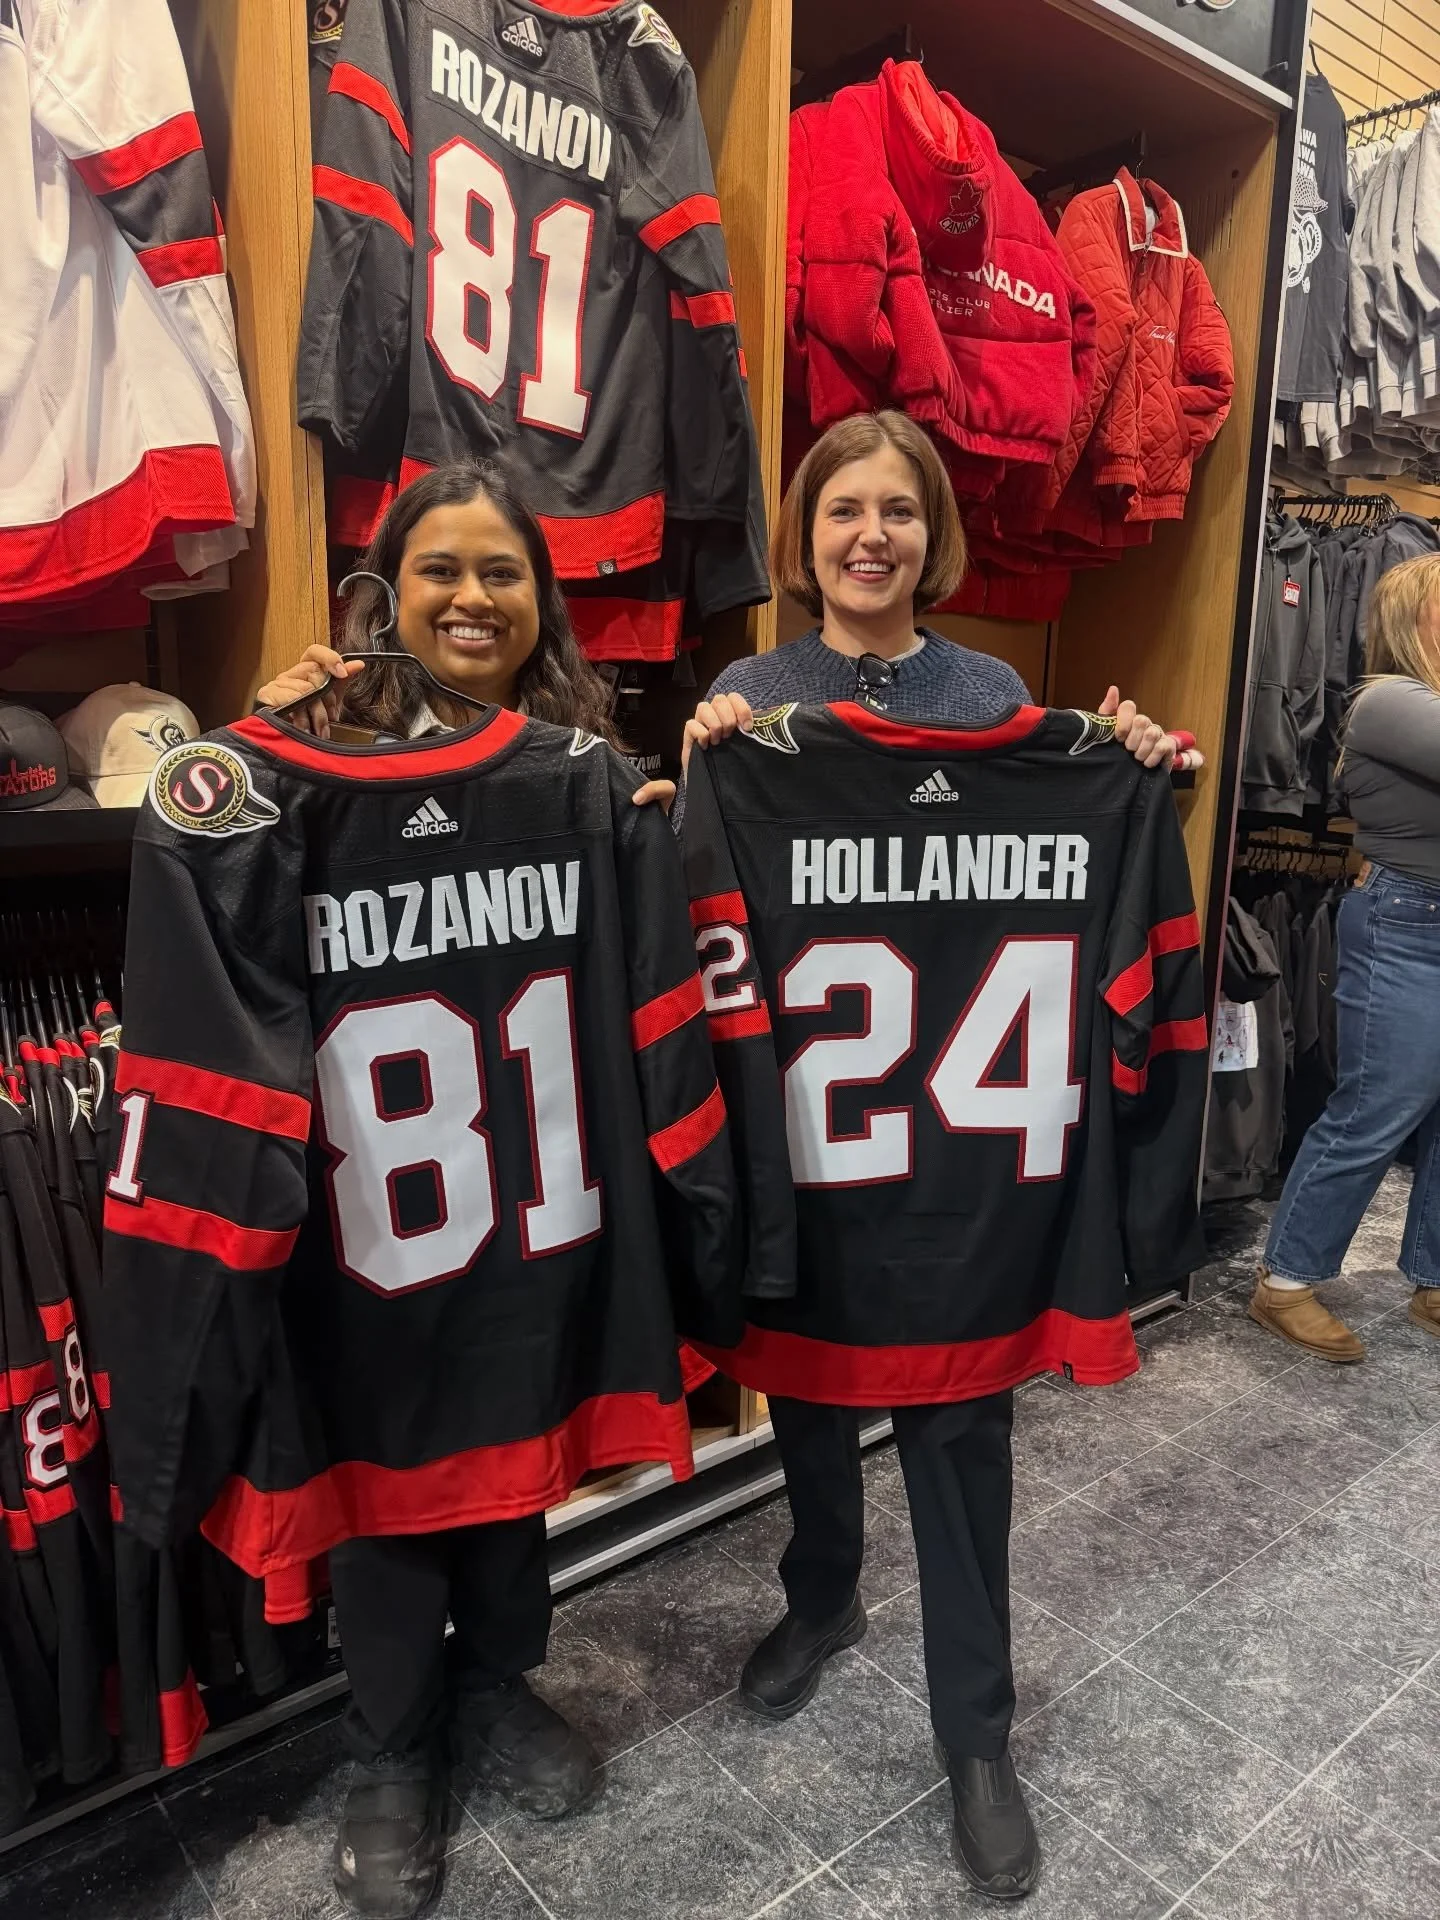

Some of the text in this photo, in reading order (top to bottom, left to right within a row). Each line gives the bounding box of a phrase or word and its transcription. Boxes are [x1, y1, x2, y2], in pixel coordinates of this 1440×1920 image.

[501, 29, 543, 57] adidas
[431, 28, 612, 182] ROZANOV
[1300, 128, 1317, 149] WA
[425, 136, 595, 440] 81
[956, 297, 991, 309] CLUB
[172, 761, 231, 814] S
[909, 790, 959, 803] adidas
[401, 820, 459, 839] adidas
[791, 835, 1090, 903] HOLLANDER
[303, 859, 581, 974] ROZANOV
[696, 923, 758, 1013] 2
[778, 934, 1085, 1184] 24
[106, 1090, 152, 1205] 1
[313, 967, 604, 1299] 81
